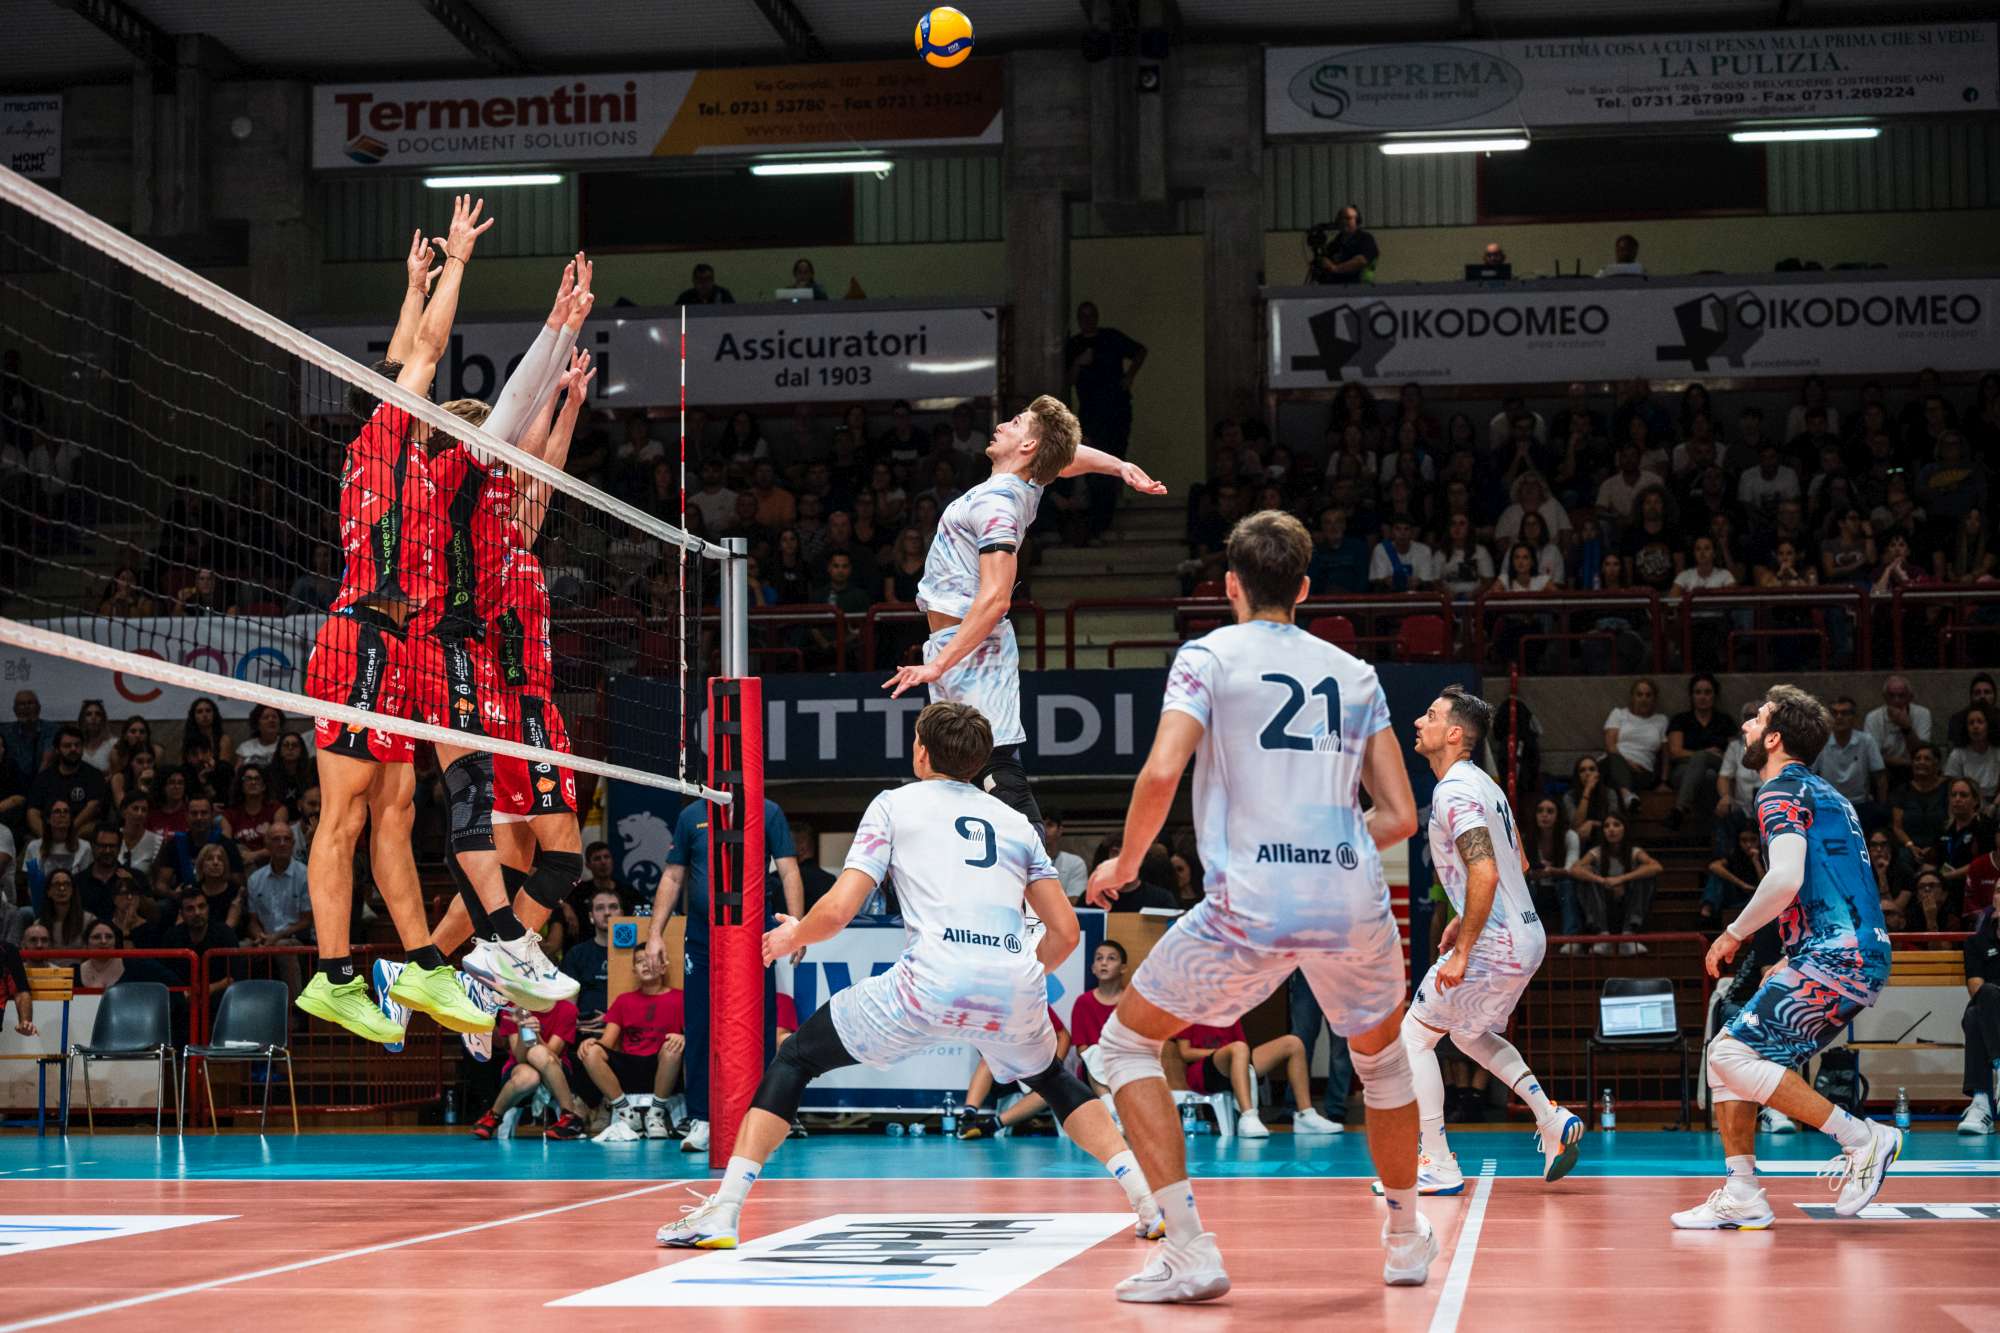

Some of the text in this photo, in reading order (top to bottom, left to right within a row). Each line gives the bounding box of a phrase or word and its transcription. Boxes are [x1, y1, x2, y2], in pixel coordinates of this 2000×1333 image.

[1604, 42, 1646, 57] COSA
[1650, 42, 1661, 55] A
[1714, 38, 1766, 52] PENSA
[1769, 36, 1796, 50] MA
[1800, 35, 1820, 49] LA
[1825, 33, 1876, 48] PRIMA
[1881, 31, 1913, 46] CHE
[1918, 31, 1931, 45] SI
[1660, 51, 1850, 77] LA PULIZIA.
[1309, 62, 1508, 119] SUPREMA
[1763, 90, 1796, 103] Fax
[334, 80, 637, 142] Termentini
[397, 129, 638, 154] DOCUMENT SOLUTIONS
[1369, 304, 1609, 340] OIKODOMEO
[1738, 293, 1981, 330] OIKODOMEO
[714, 325, 928, 363] Assicuratori
[774, 366, 872, 388] dal 1903
[1037, 693, 1134, 757] DI
[1259, 673, 1342, 753] 21
[349, 733, 355, 748] 1
[542, 794, 552, 808] 21
[954, 816, 998, 868] 9
[1256, 843, 1332, 864] Allianz
[942, 927, 1001, 948] Allianz
